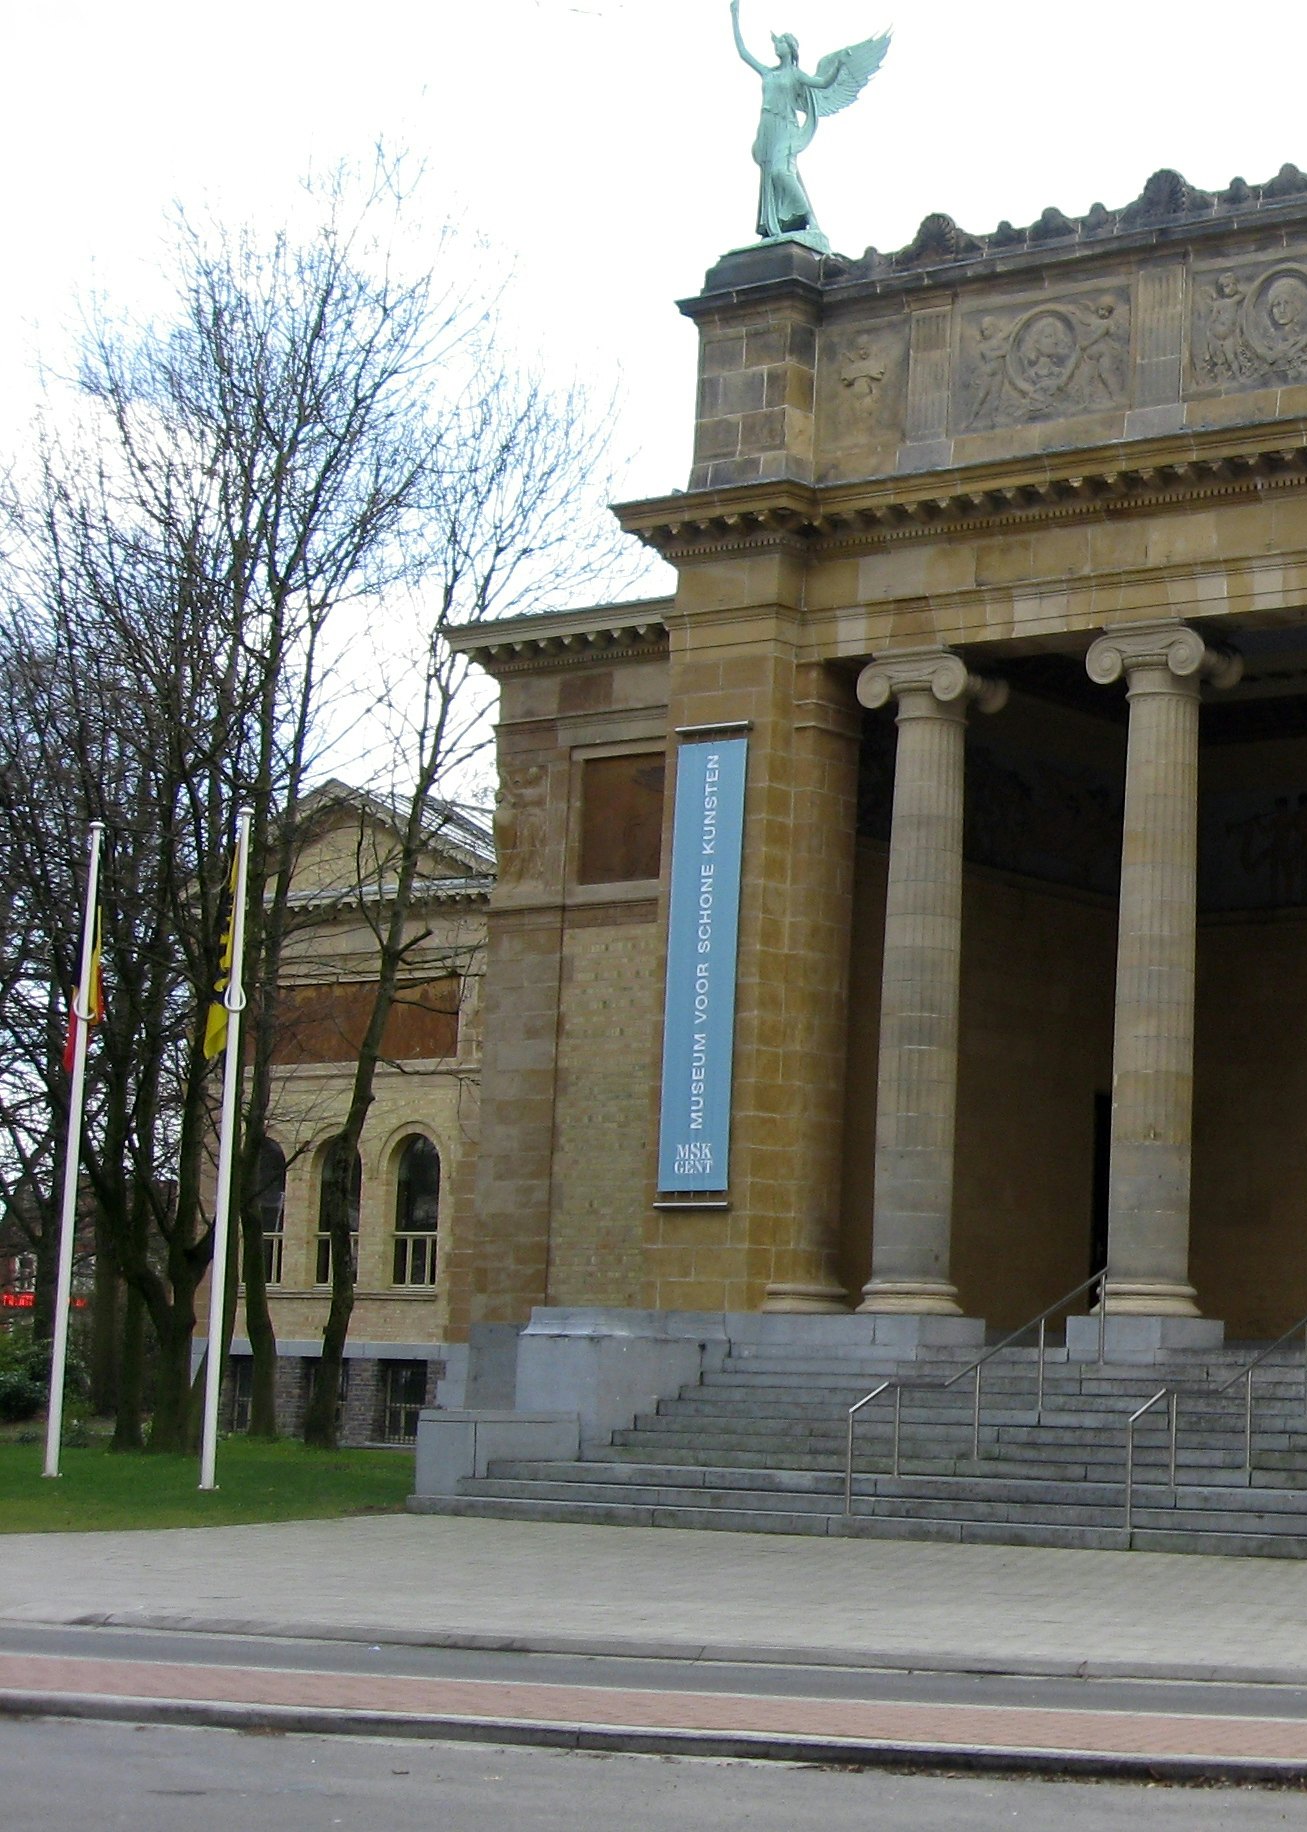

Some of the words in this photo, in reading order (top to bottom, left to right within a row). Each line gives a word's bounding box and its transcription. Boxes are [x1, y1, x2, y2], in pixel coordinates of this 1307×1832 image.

[701, 755, 719, 855] KUNSTEN
[697, 863, 714, 954] SCHONE
[694, 963, 709, 1025] VOOR
[690, 1033, 707, 1129] MUSEUM
[674, 1159, 713, 1174] GENT
[675, 1143, 712, 1159] MSK
